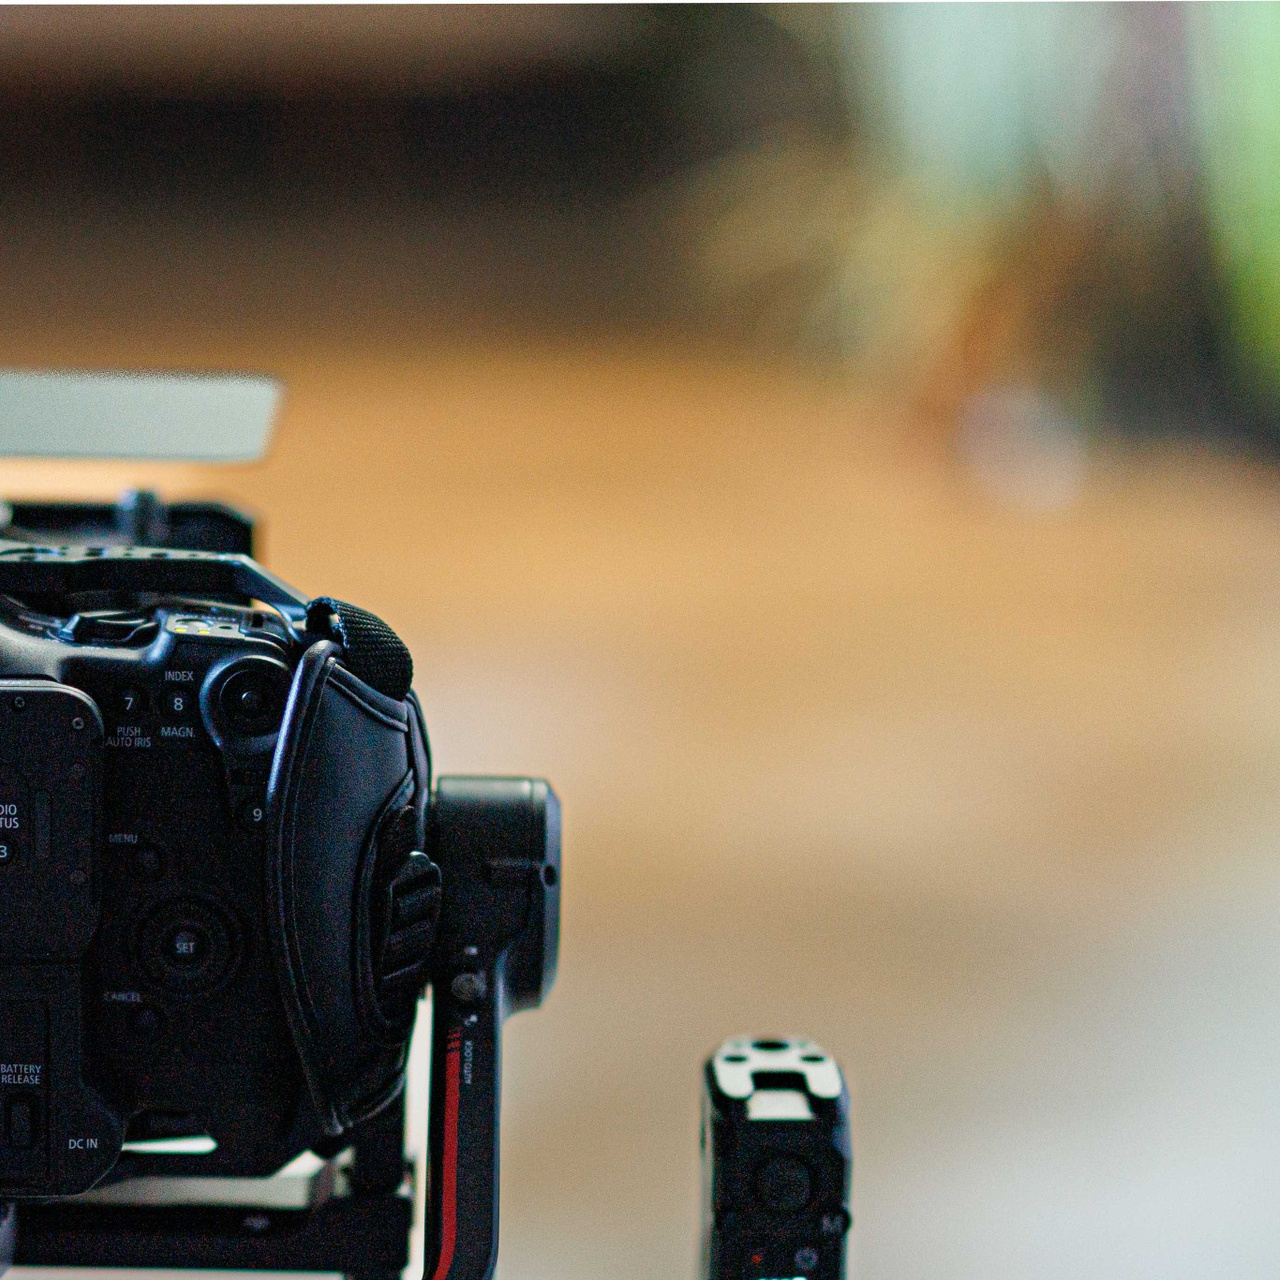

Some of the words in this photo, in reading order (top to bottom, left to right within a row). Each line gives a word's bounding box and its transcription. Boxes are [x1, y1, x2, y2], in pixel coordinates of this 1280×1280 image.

[164, 671, 194, 681] INDEX
[124, 697, 134, 710] 7
[173, 697, 184, 711] 8
[117, 726, 141, 737] PUSH
[160, 726, 196, 738] MAGN.
[105, 737, 133, 747] AUTO
[134, 737, 152, 748] IRIS
[253, 808, 262, 822] 9
[176, 942, 195, 953] SET
[0, 1064, 42, 1074] BATTERY
[1, 1074, 41, 1085] RELEASE
[68, 1139, 84, 1149] DC
[86, 1138, 99, 1149] IN
